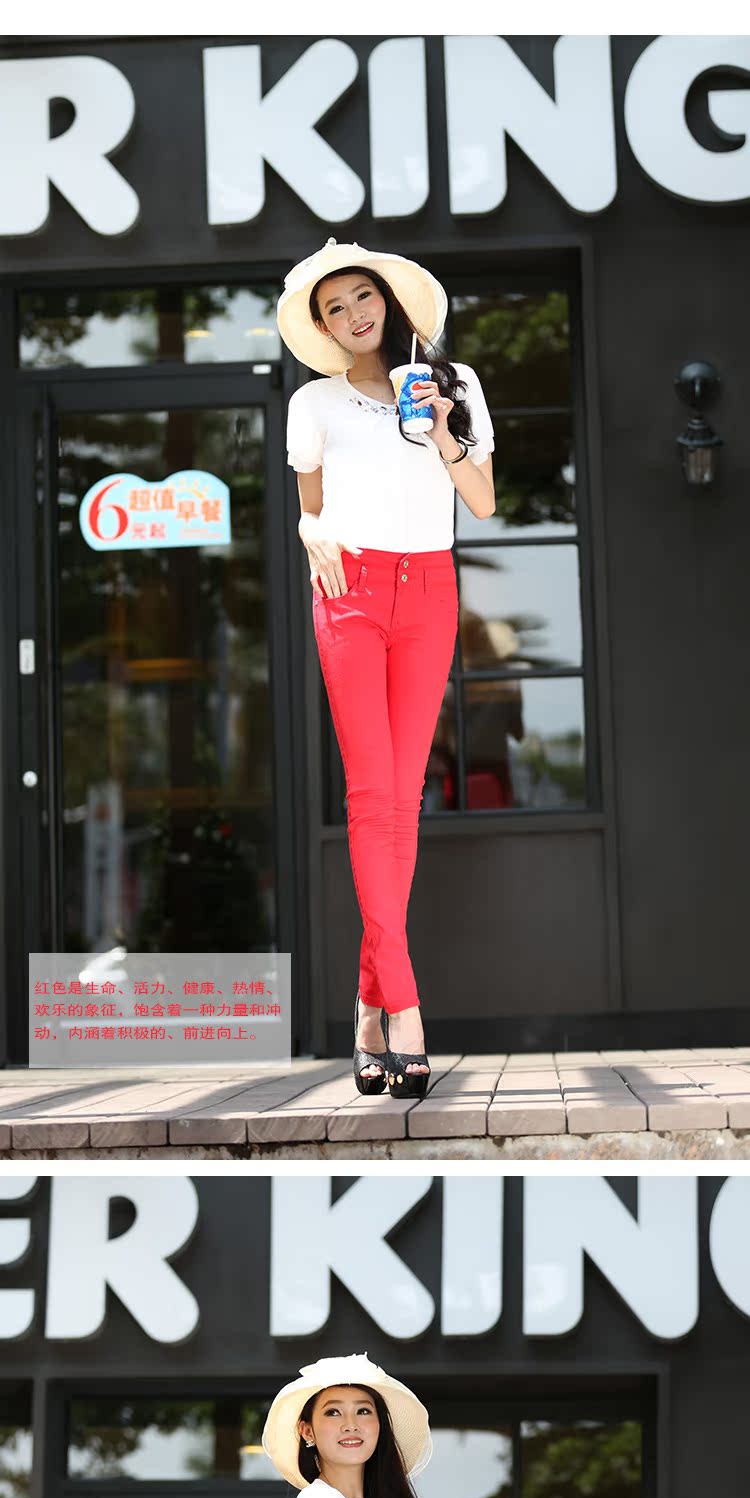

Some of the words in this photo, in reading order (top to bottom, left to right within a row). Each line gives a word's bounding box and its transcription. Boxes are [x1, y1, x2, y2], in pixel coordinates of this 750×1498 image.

[203, 35, 750, 225] KING
[89, 479, 128, 541] 6
[269, 1176, 750, 1339] KIN
